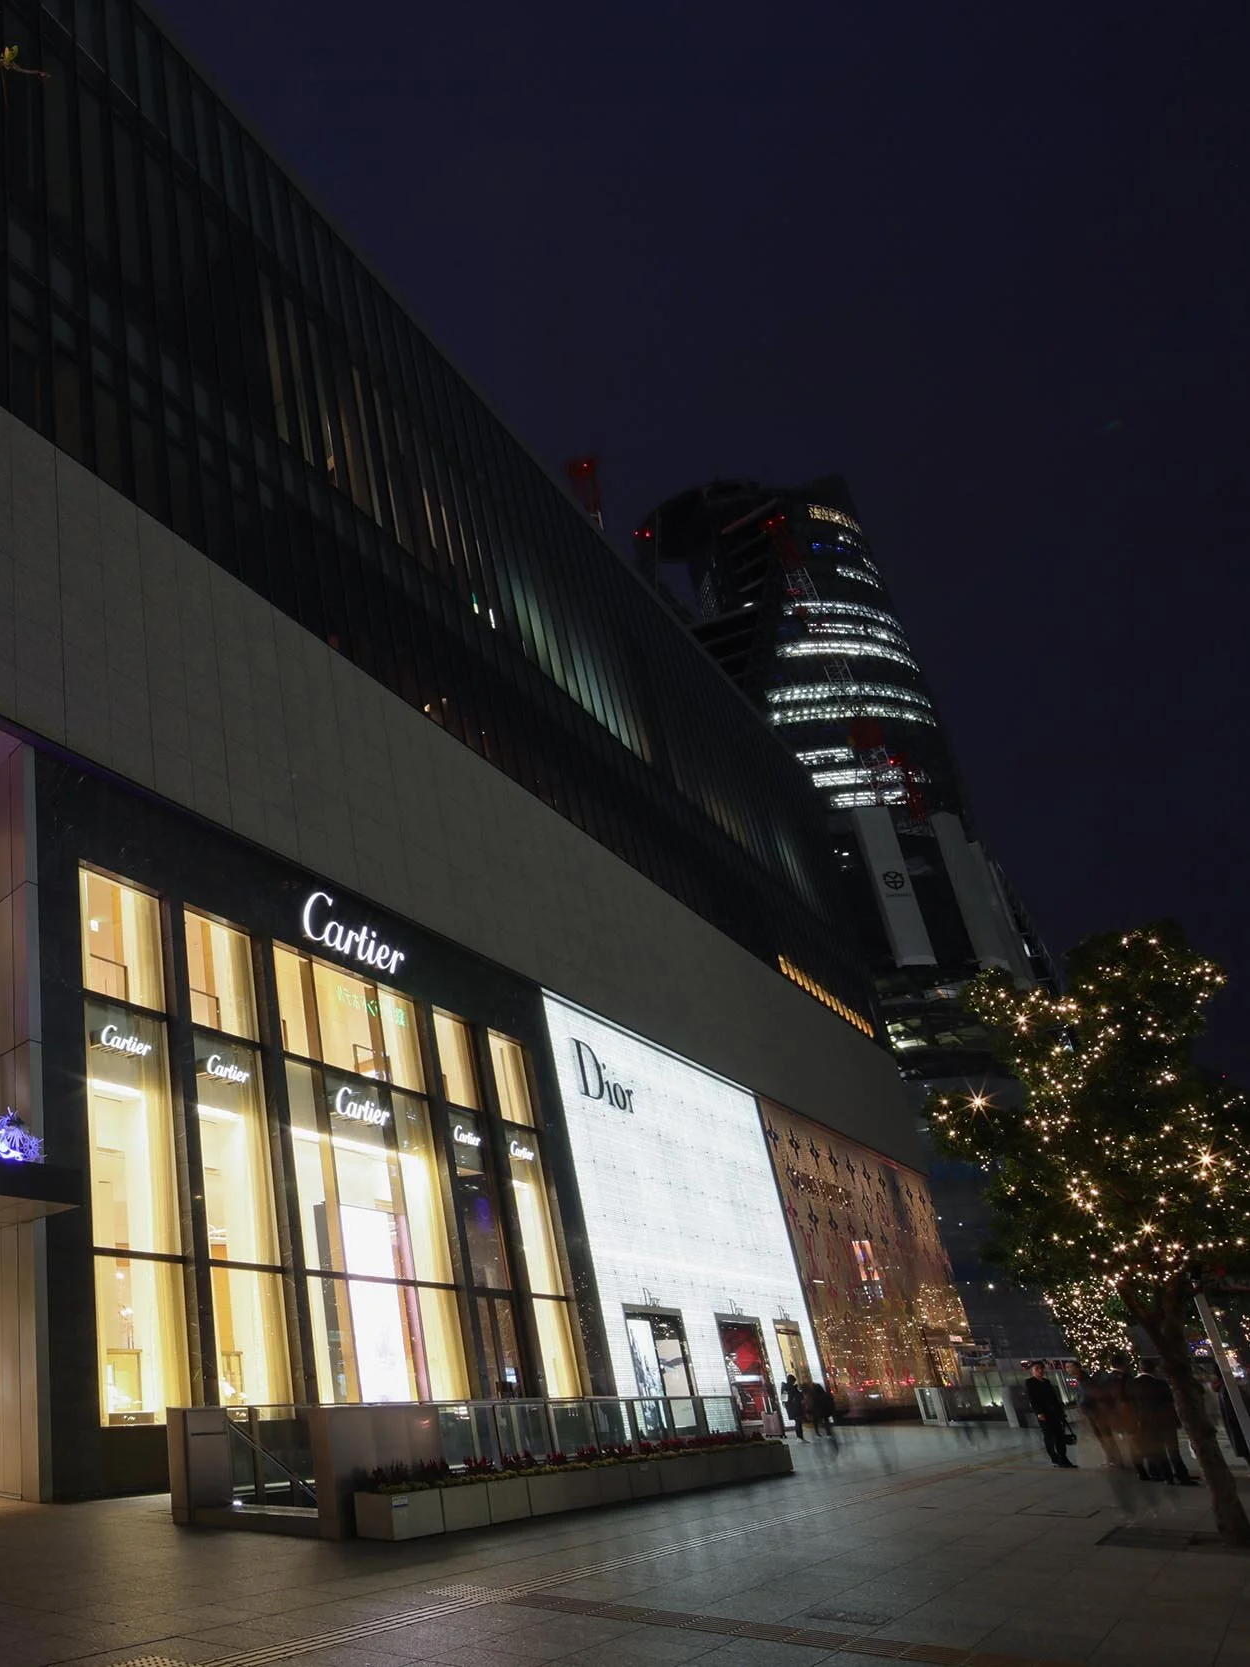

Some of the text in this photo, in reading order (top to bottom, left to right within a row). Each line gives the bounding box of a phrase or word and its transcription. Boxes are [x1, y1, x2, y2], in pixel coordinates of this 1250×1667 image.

[302, 891, 406, 975] Cartier
[101, 1024, 152, 1057] Cartier
[206, 1054, 250, 1084] Cartier
[570, 1037, 635, 1115] Dior
[335, 1086, 390, 1127] Cartier
[453, 1124, 482, 1147] Cartier
[510, 1140, 535, 1161] Cartier
